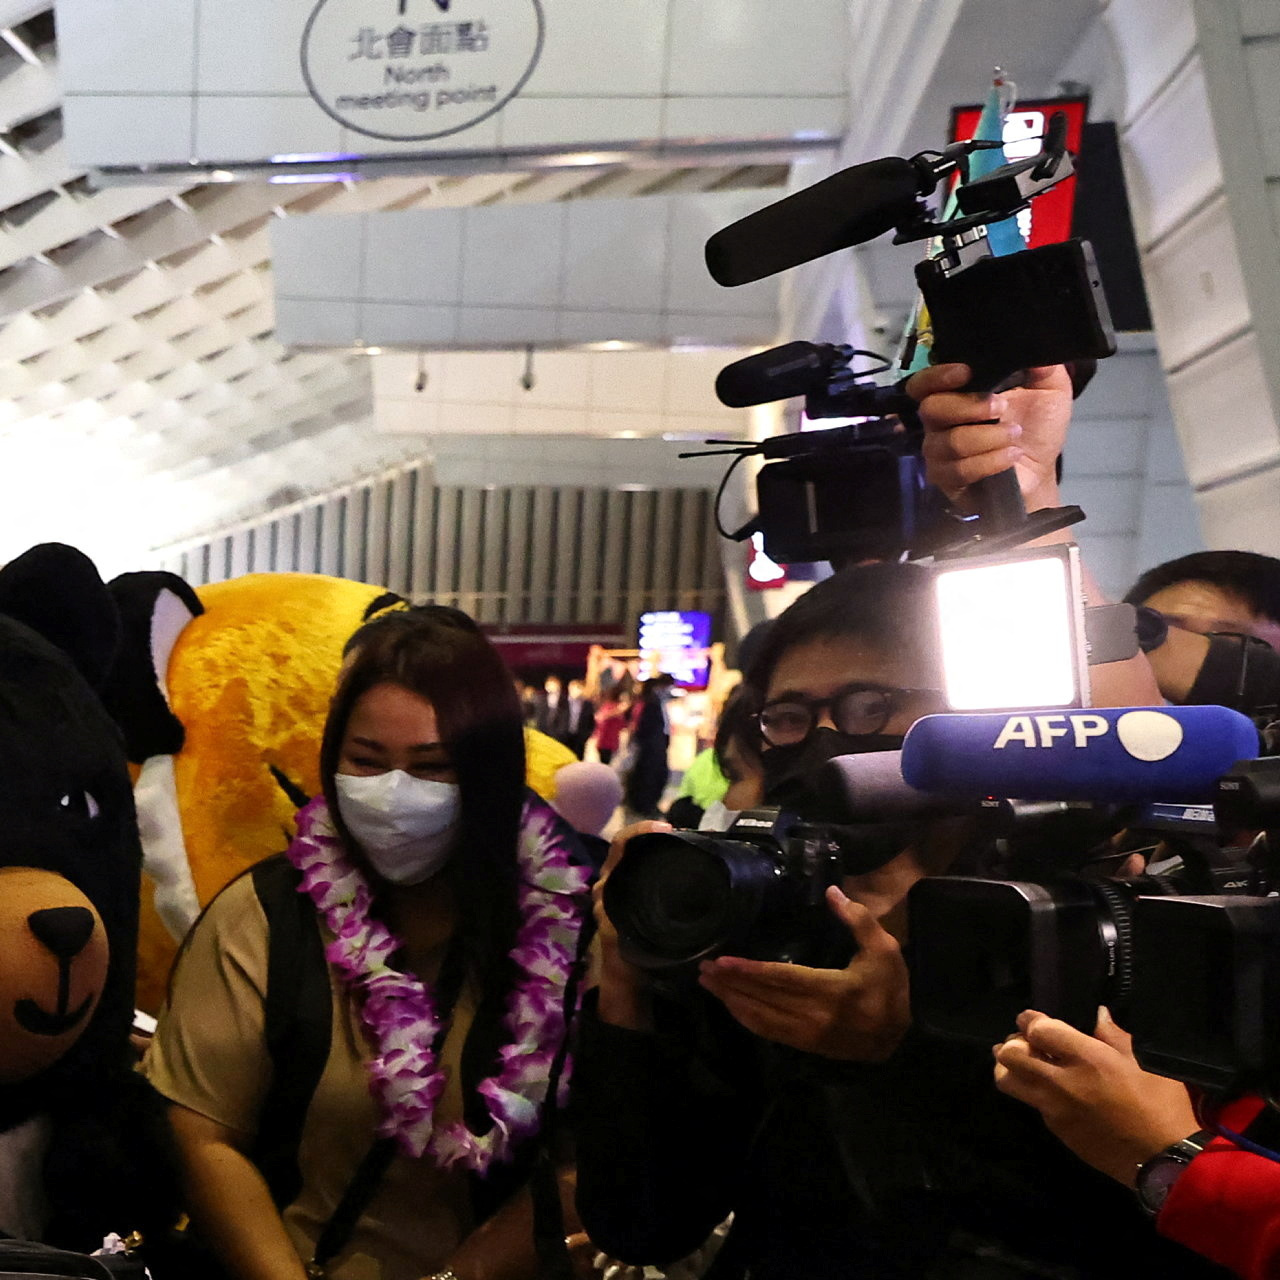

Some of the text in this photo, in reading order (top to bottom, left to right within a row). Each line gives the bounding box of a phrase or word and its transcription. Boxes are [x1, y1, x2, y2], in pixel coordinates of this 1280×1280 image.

[384, 63, 451, 84] North
[336, 84, 496, 112] meeting point
[993, 714, 1110, 749] AFP
